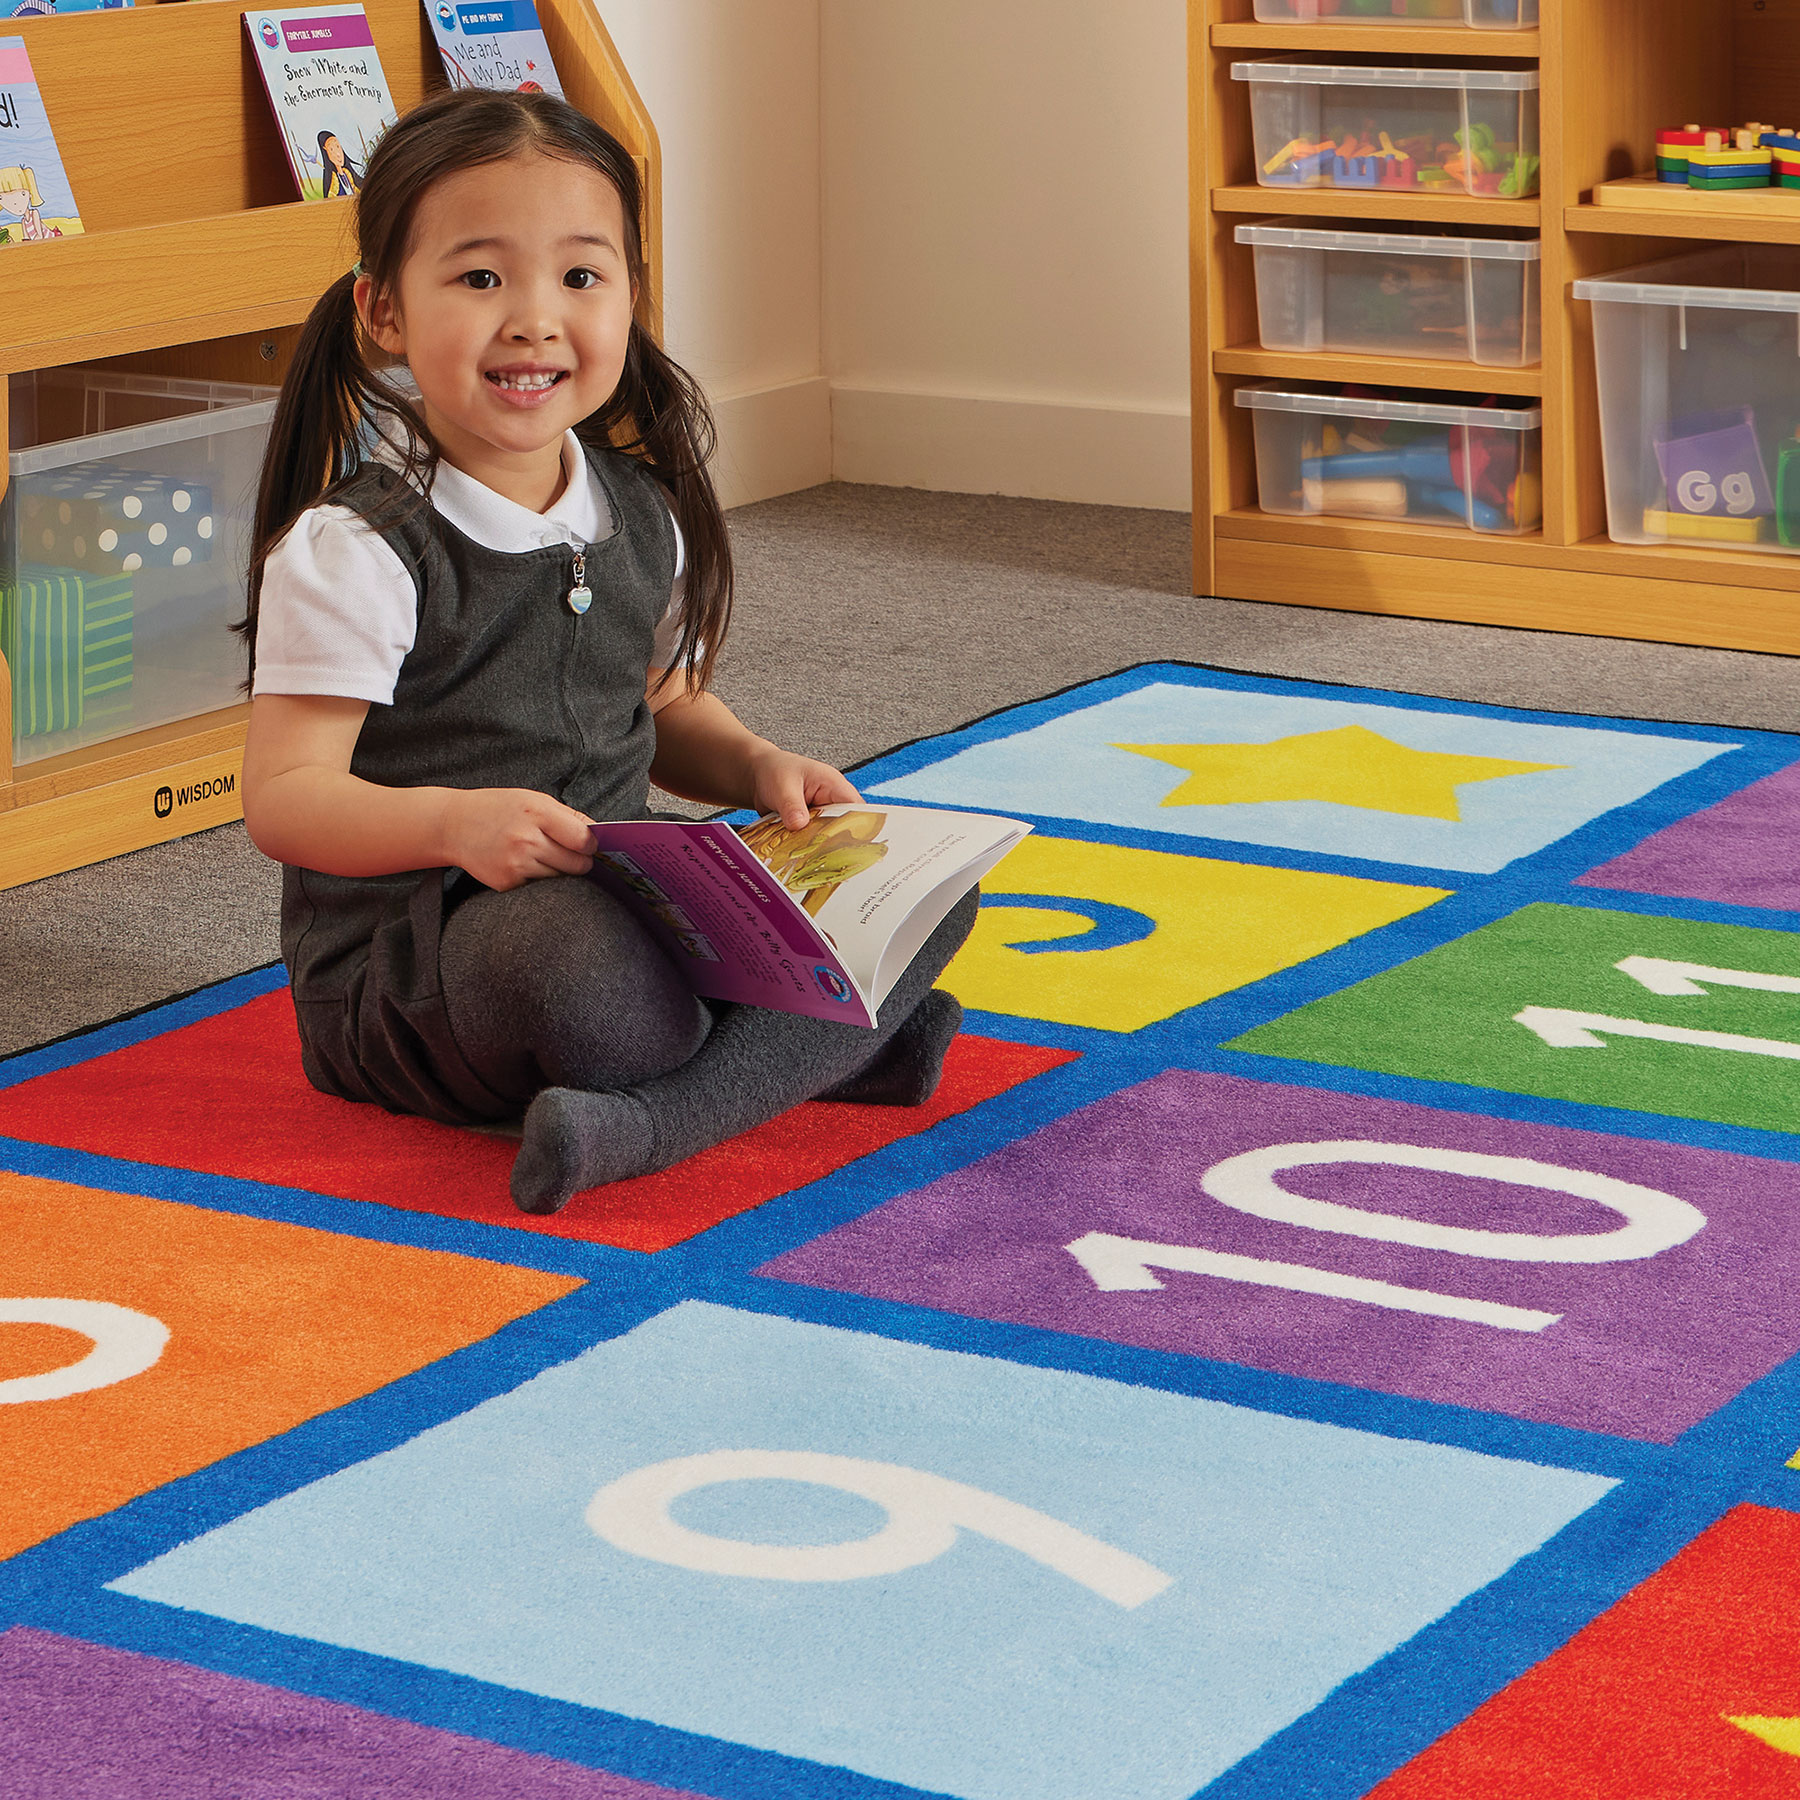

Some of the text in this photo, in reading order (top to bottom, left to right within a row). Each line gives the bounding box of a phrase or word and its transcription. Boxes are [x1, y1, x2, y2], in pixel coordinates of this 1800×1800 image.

[454, 36, 502, 64] Me and
[284, 58, 369, 81] Snow White and
[473, 60, 523, 88] My Dad
[284, 80, 382, 107] the Enormous Turnip
[1677, 470, 1755, 514] Gg
[176, 774, 235, 807] WISDOM
[700, 835, 740, 871] FAIRYTALE
[737, 870, 772, 904] JUMBLES
[860, 903, 881, 925] braid
[1063, 1140, 1707, 1333] 10
[585, 1450, 1175, 1611] 9
